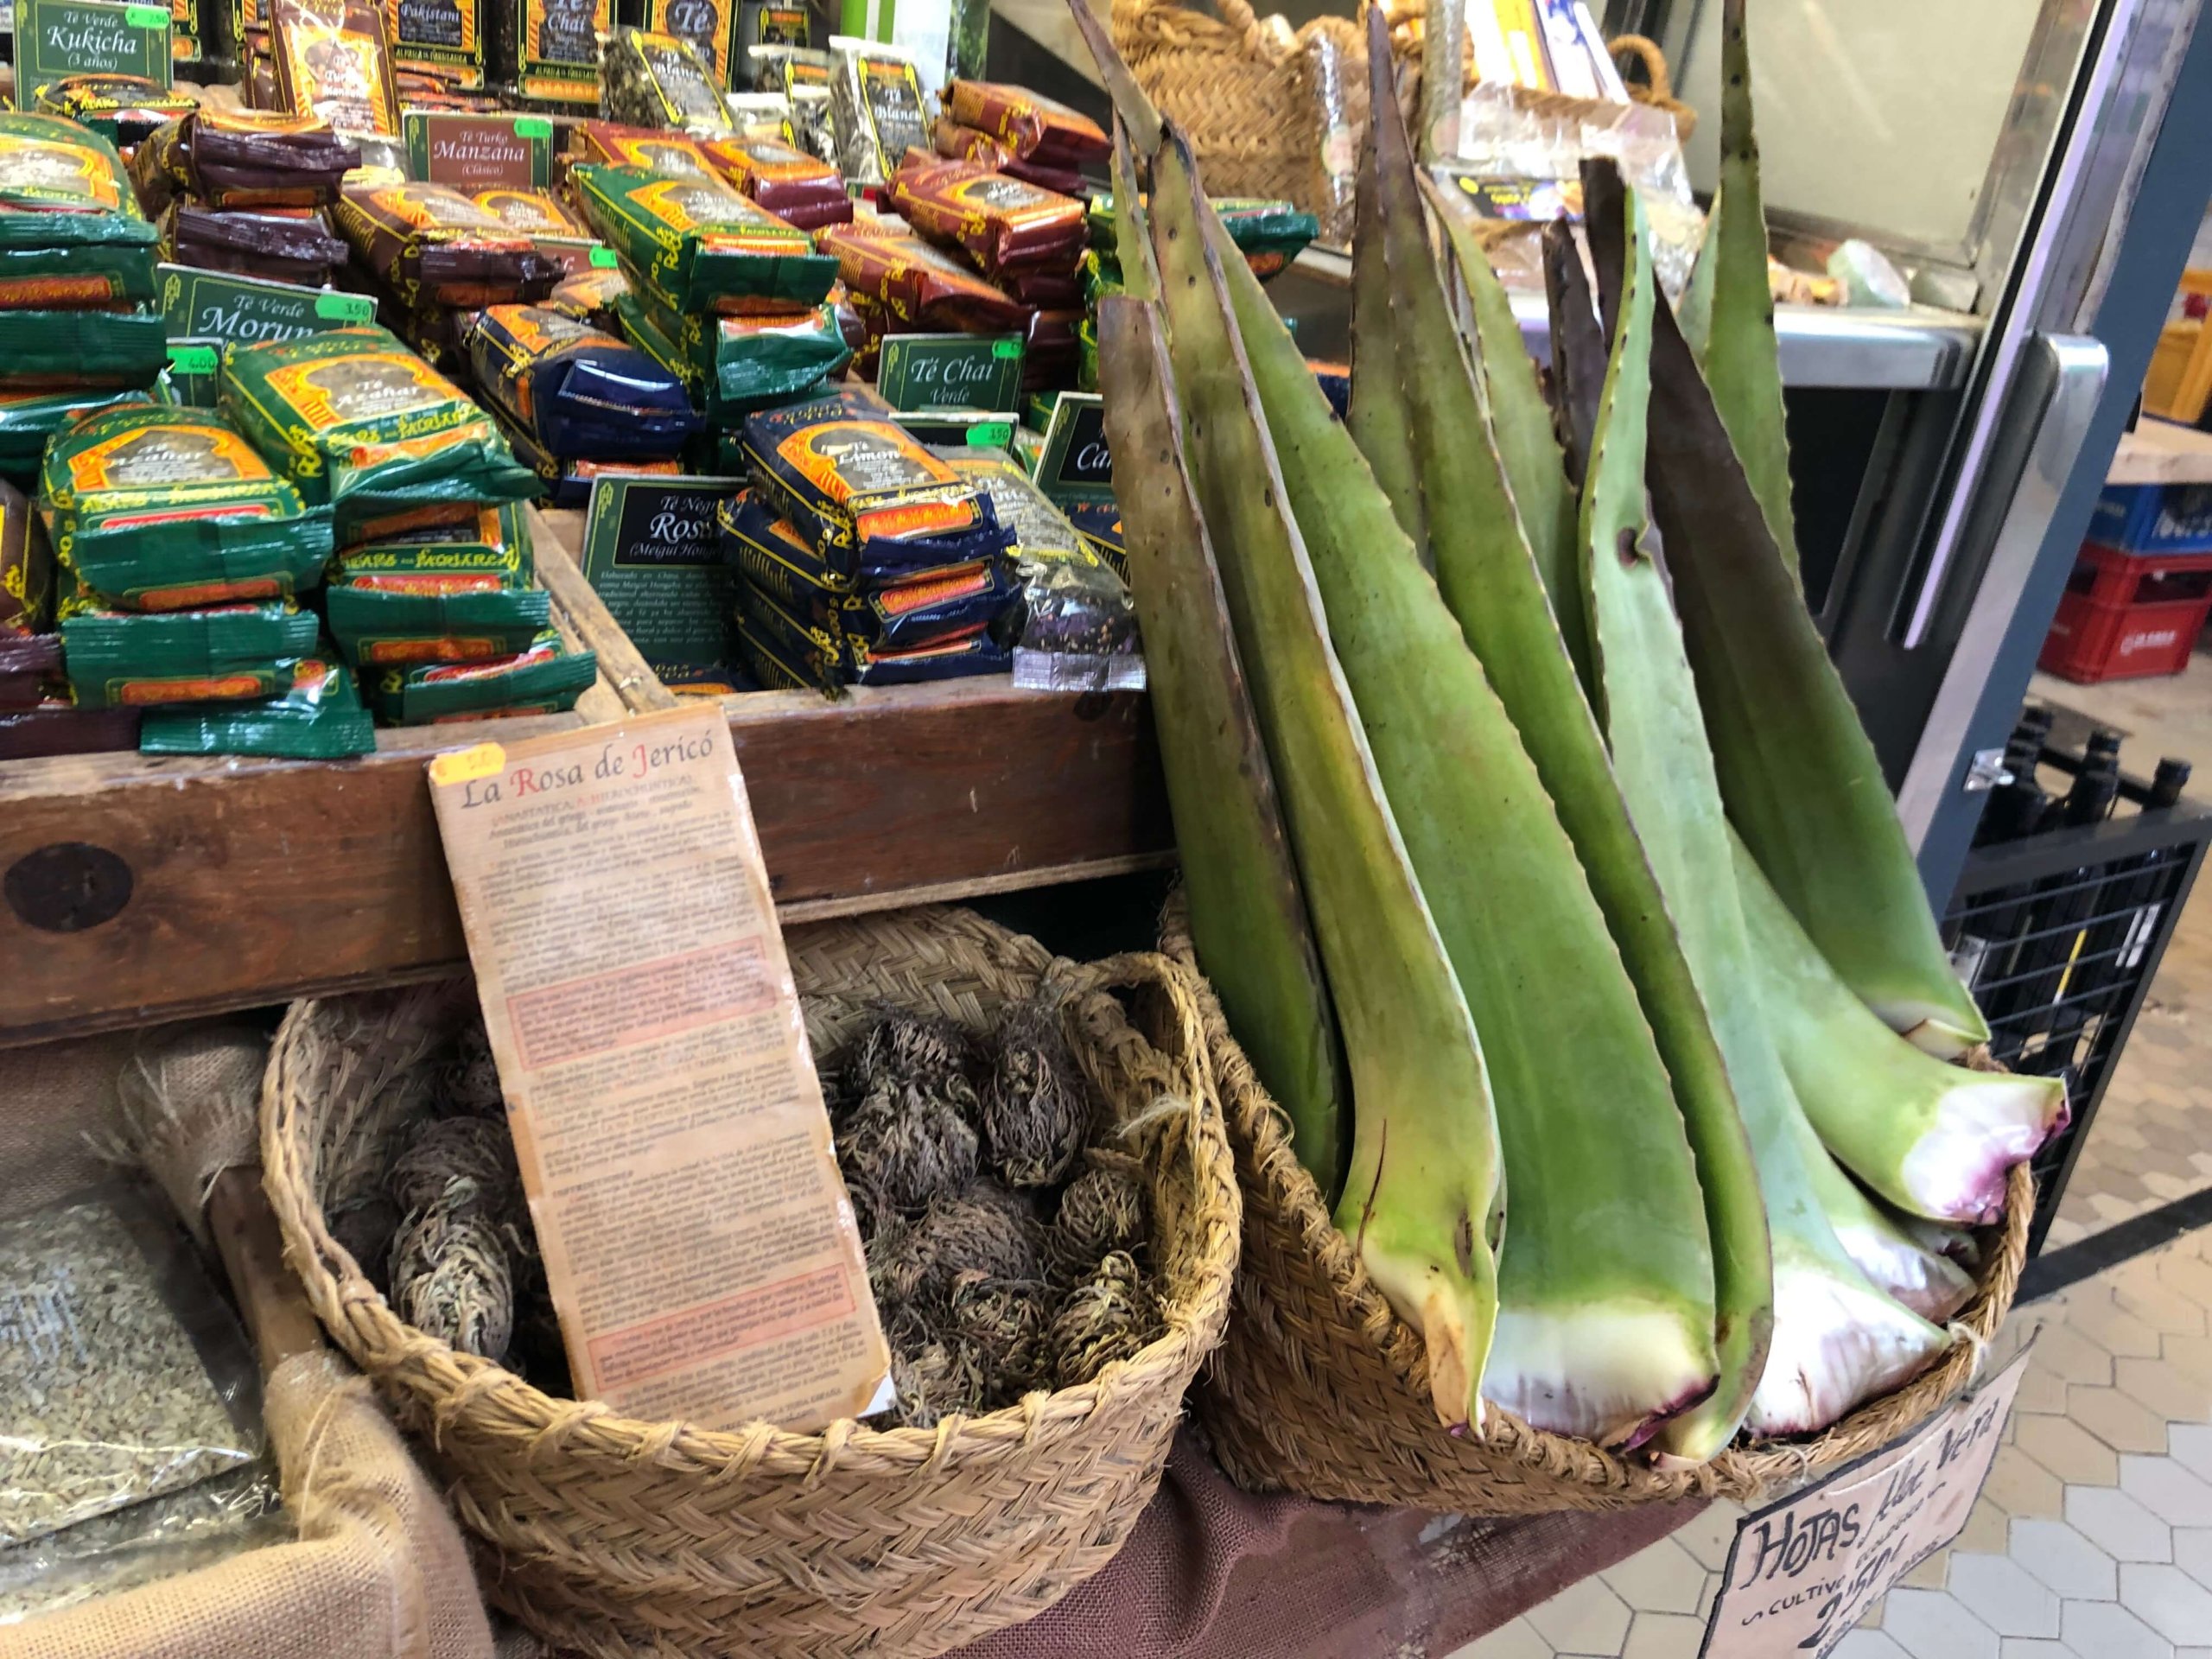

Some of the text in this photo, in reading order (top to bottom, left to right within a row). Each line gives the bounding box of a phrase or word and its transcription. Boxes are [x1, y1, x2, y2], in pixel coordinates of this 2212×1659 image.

[64, 10, 118, 28] Té Verde
[400, 3, 460, 22] Pakistani
[548, 13, 586, 32] Chai
[674, 1, 709, 33] Té
[47, 25, 137, 55] Kukicha
[67, 54, 118, 71] (3 años)
[460, 130, 508, 145] Té Turko
[434, 140, 525, 162] Manzana
[234, 294, 306, 319] Té Verde
[198, 306, 315, 343] Morun
[911, 355, 995, 385] Té Chai
[931, 385, 970, 404] Verde
[660, 495, 678, 511] Té
[649, 512, 705, 544] Ros
[461, 729, 715, 810] La Rosa de Jericó
[1739, 1503, 1859, 1591] HOJAS
[1936, 1396, 2001, 1471] Vera
